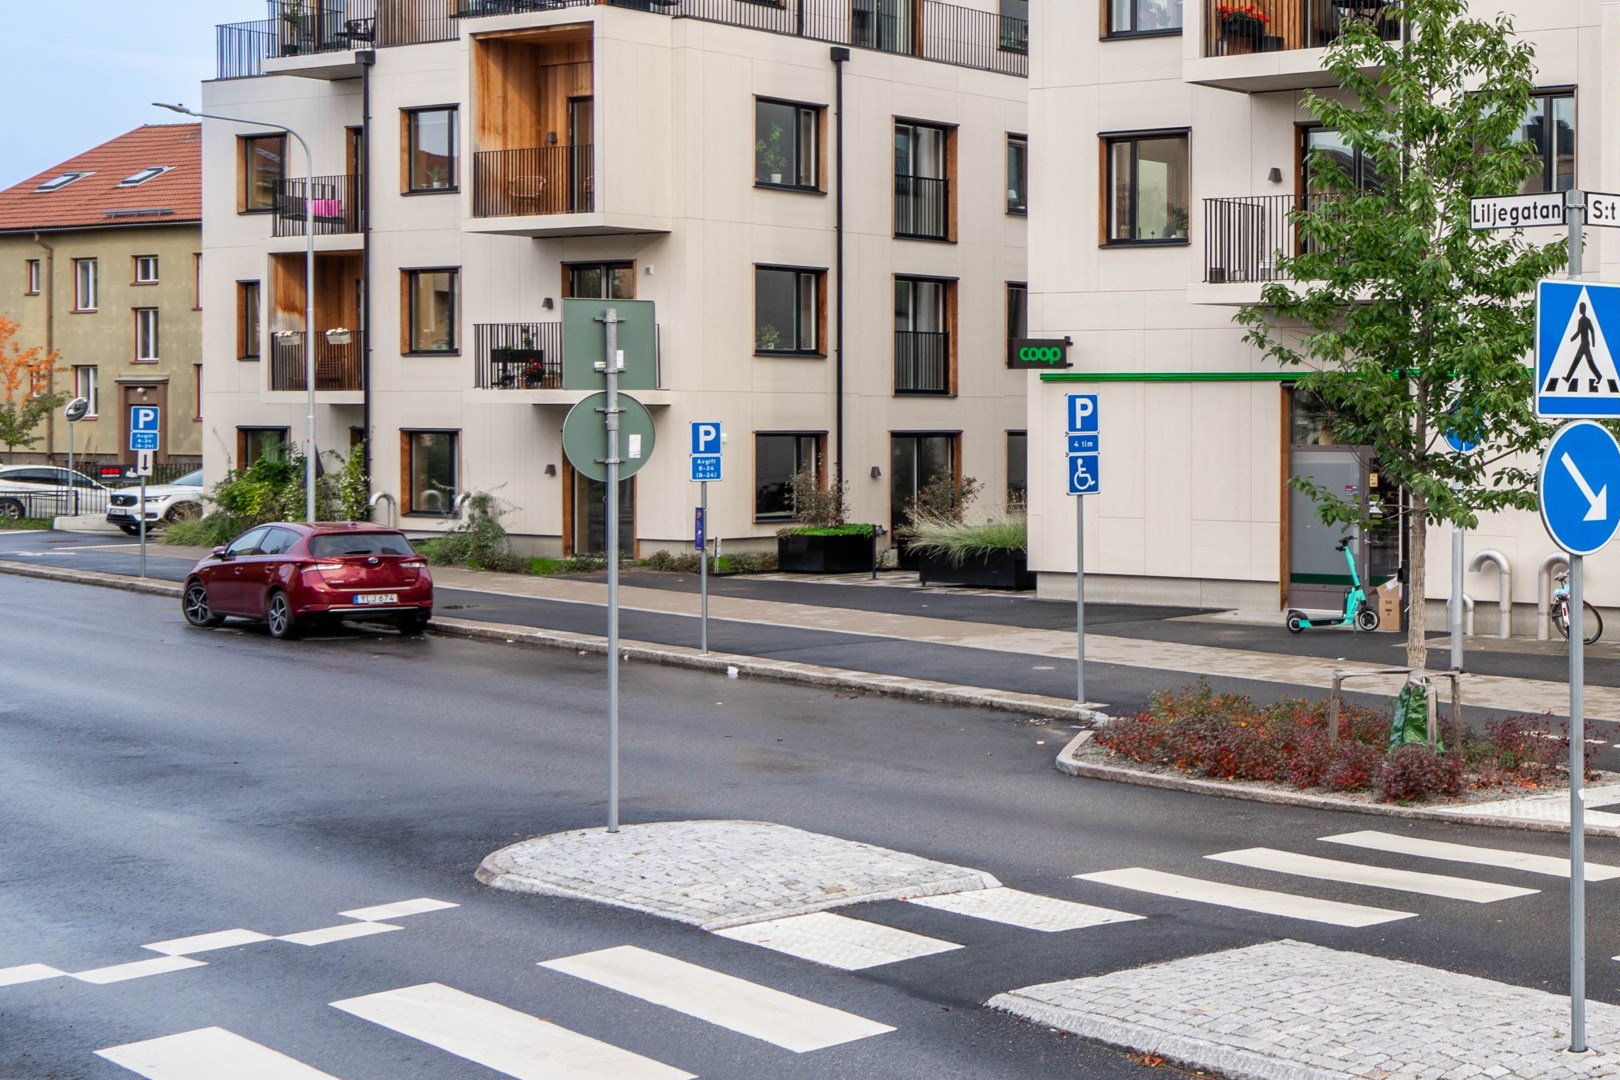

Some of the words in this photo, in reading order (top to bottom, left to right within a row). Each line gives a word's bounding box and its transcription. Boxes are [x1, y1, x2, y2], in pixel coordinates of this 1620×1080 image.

[1472, 200, 1561, 226] Liljegatan
[1593, 199, 1616, 221] S:t
[1020, 347, 1061, 365] coop
[139, 409, 154, 429] P
[1075, 397, 1094, 429] P
[699, 425, 717, 452] P
[1081, 439, 1093, 447] tim
